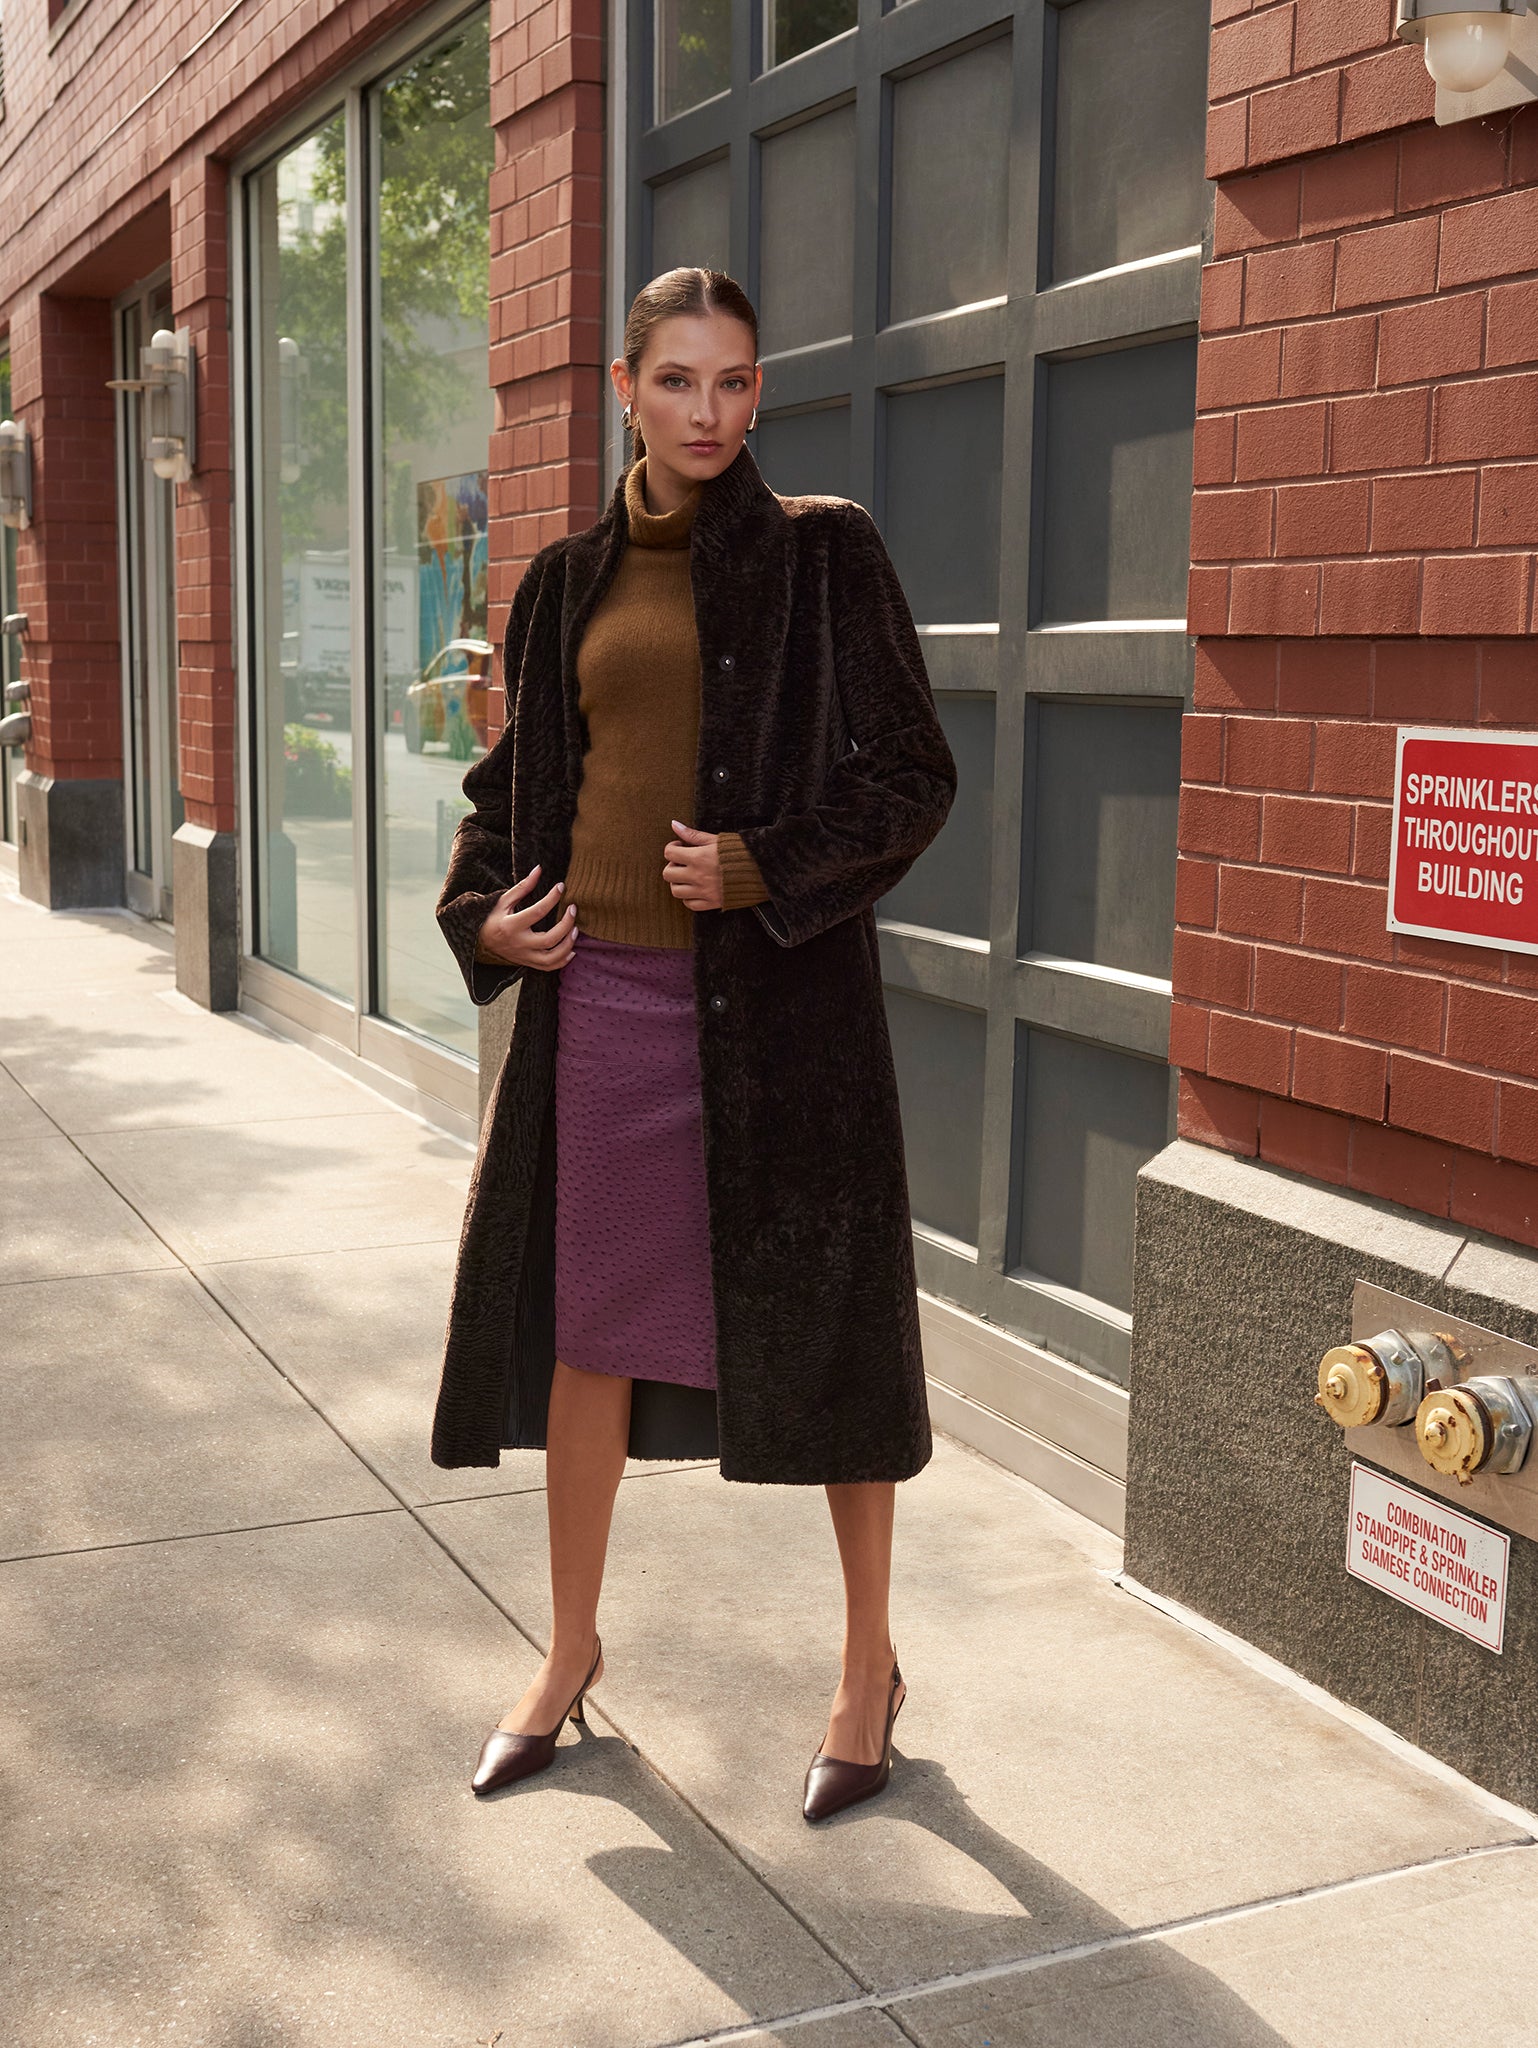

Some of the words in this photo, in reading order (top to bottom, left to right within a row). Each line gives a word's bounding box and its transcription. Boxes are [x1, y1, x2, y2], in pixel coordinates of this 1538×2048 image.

[1418, 861, 1524, 906] BUILDING
[1356, 1511, 1417, 1560] STANDPIPE
[1419, 1545, 1428, 1567] &
[1431, 1550, 1498, 1602] SPRINKLER
[1387, 1502, 1467, 1560] COMBINATION
[1362, 1540, 1411, 1583] SIAMESE
[1413, 1567, 1488, 1623] CONNECTION
